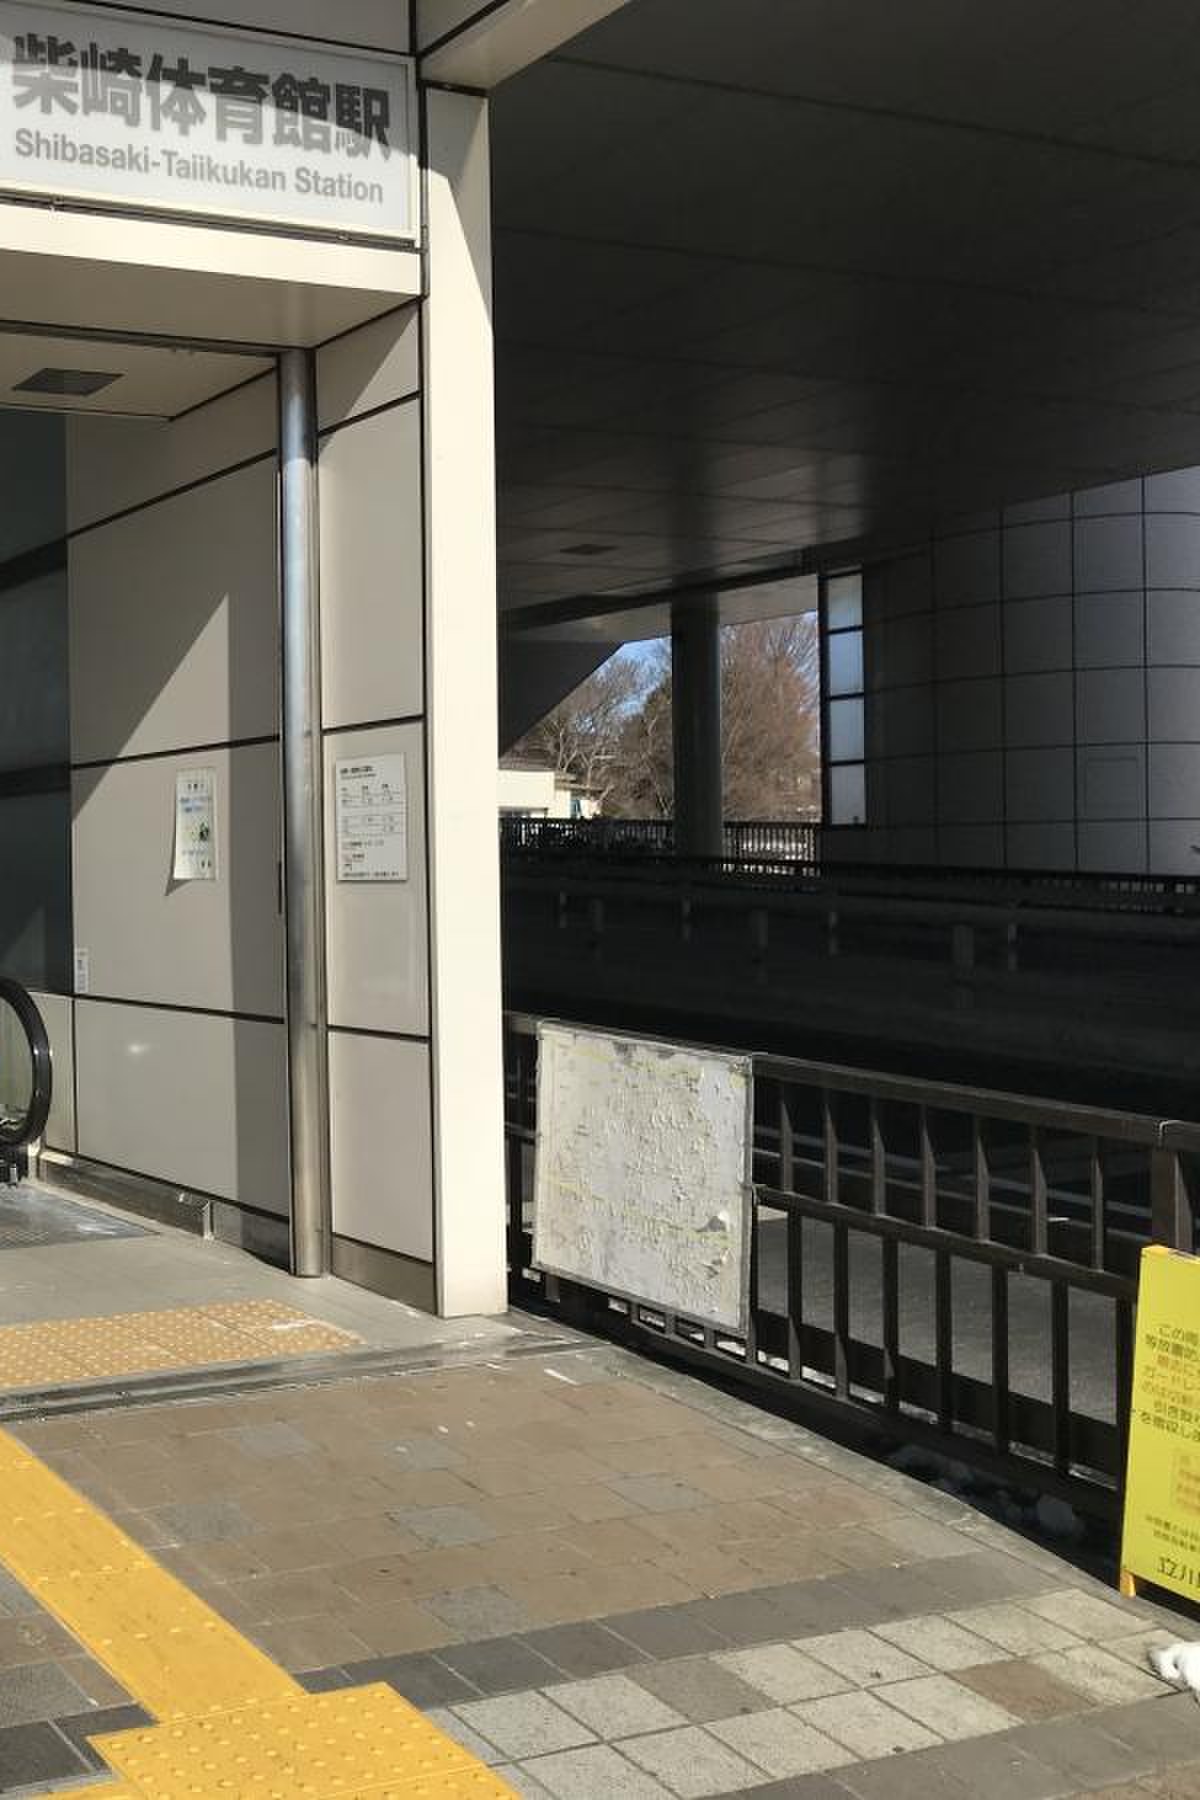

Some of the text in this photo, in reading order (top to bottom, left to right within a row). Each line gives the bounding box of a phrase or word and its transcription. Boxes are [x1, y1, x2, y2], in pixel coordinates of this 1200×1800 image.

[12, 32, 392, 160] 柴崎体育館駅
[15, 127, 383, 203] Shibasaki-Taiikukan Station
